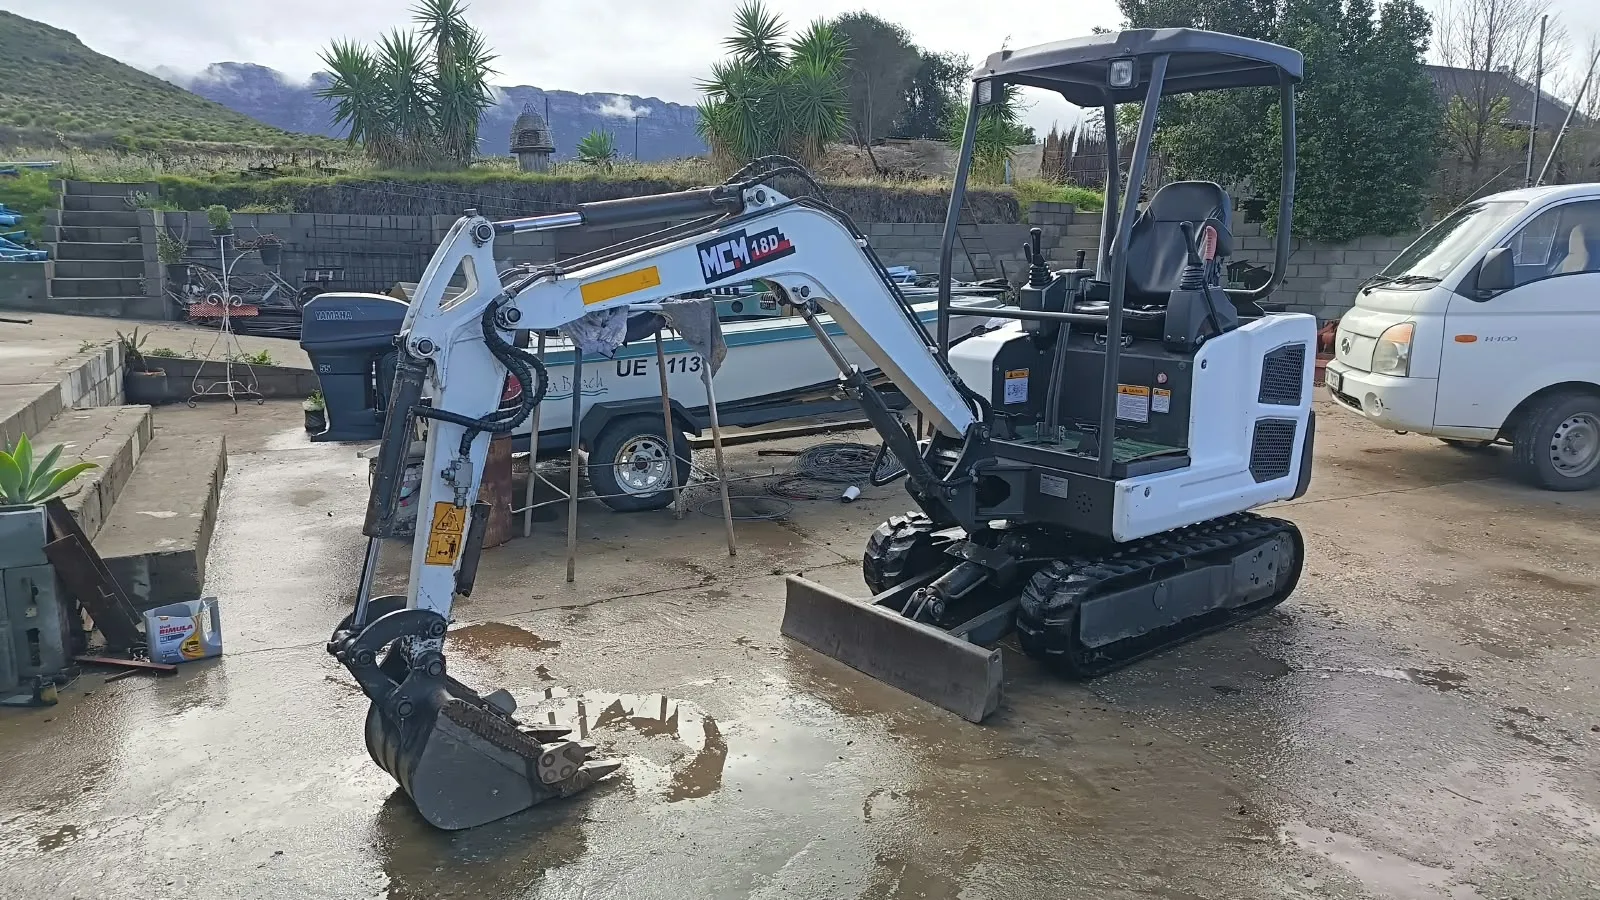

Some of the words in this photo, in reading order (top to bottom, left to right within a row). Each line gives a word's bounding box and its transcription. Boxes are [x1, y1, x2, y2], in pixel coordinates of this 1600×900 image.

[700, 236, 750, 279] MCM
[752, 234, 779, 256] 18D
[314, 310, 353, 321] YAMAHA
[319, 364, 332, 373] 55
[616, 359, 648, 377] UE
[656, 356, 703, 373] 113
[159, 624, 193, 635] RIMULA
